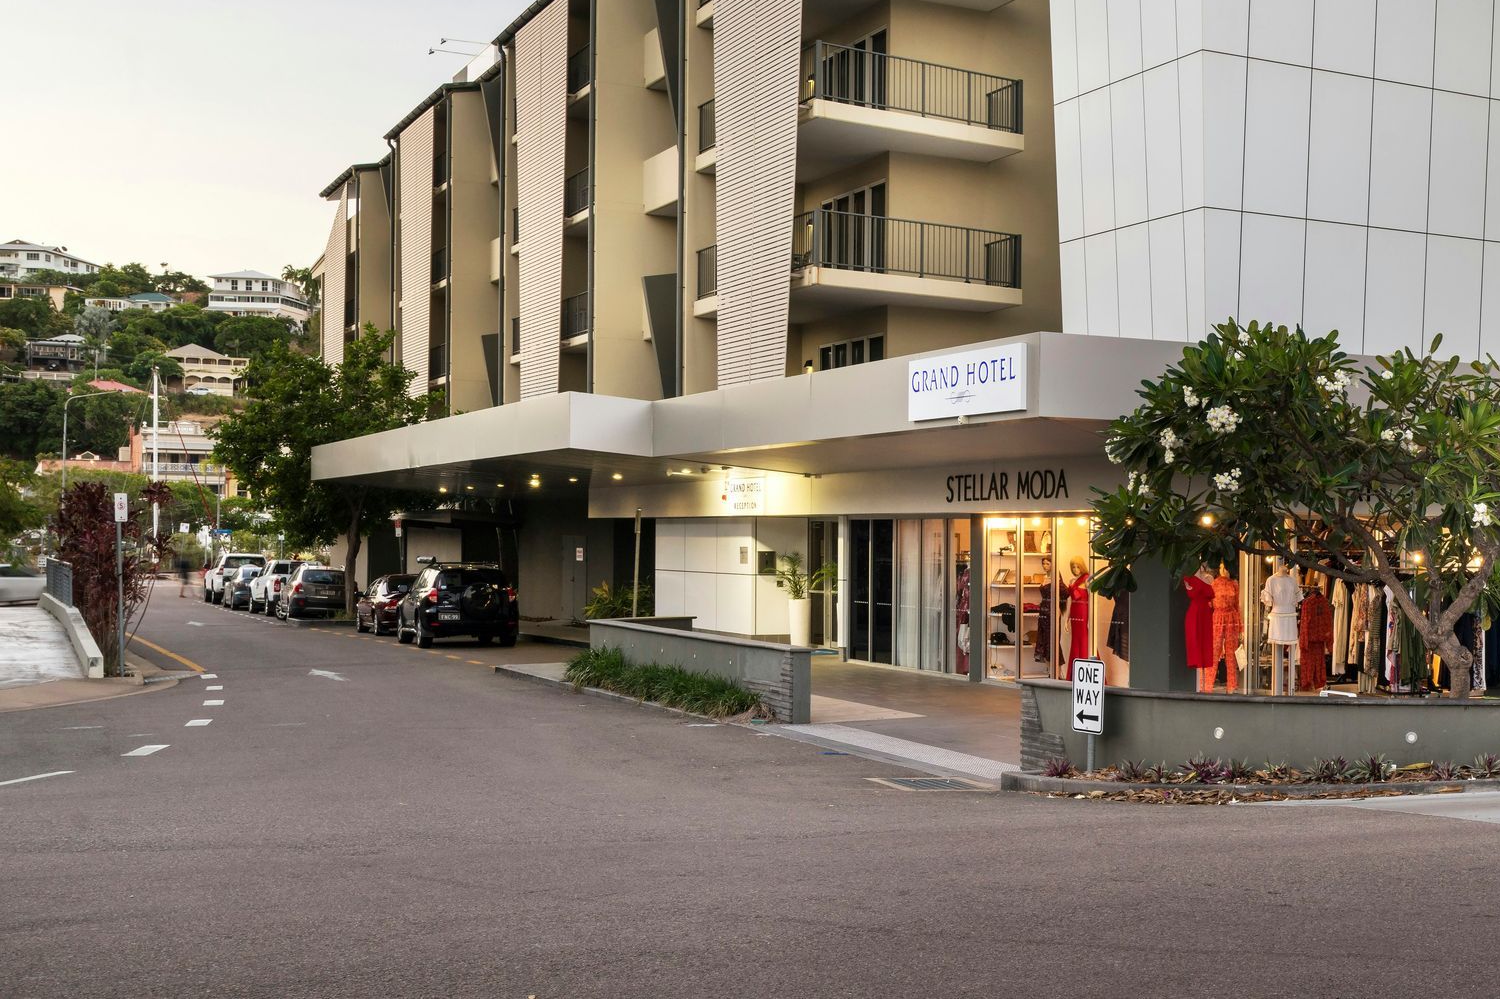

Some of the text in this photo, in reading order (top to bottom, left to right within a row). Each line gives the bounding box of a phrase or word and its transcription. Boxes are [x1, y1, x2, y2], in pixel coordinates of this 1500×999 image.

[912, 357, 1016, 393] GRAND HOTEL
[946, 469, 1069, 503] STELLAR MODA
[1078, 667, 1099, 684] ONE
[1076, 688, 1100, 706] WAY
